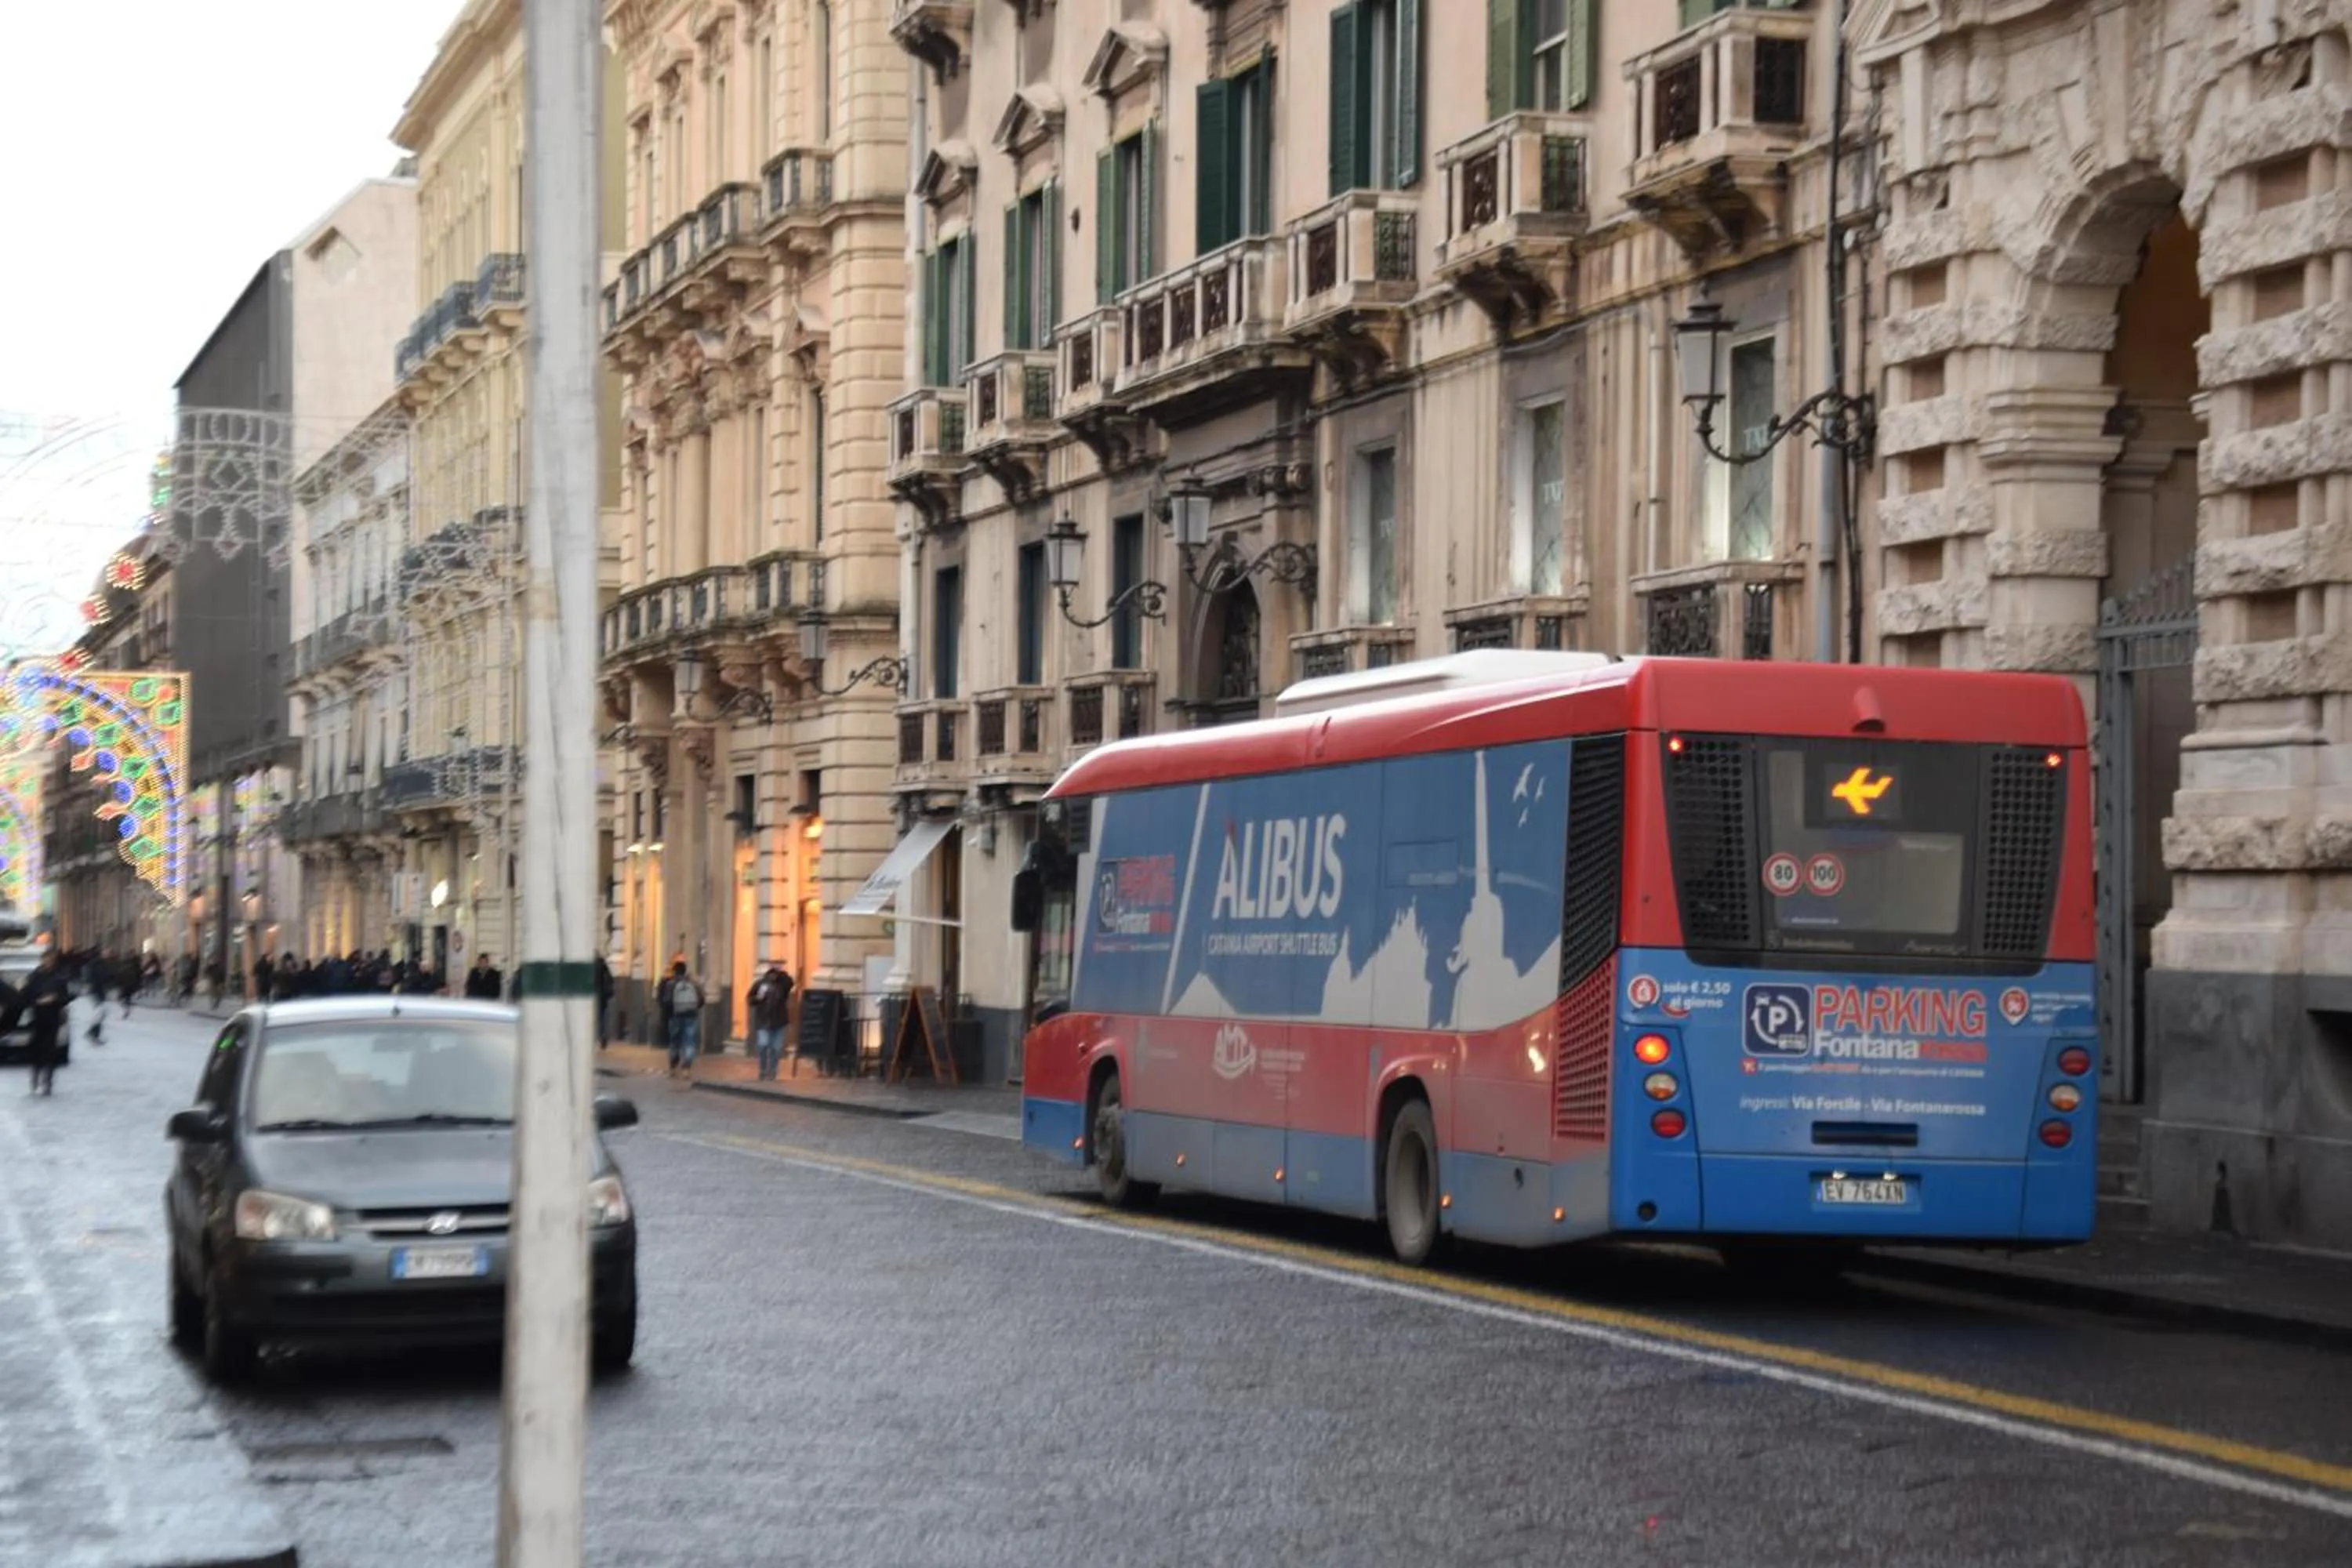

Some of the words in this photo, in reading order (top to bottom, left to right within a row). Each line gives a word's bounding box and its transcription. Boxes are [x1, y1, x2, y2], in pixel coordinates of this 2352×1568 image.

[1212, 813, 1347, 920] ALIBUS
[1774, 864, 1794, 881] 80
[1813, 865, 1836, 882] 100
[1318, 932, 1338, 956] BUS
[1768, 1005, 1788, 1033] P
[1813, 985, 1987, 1037] PARKING
[1813, 1030, 1919, 1059] Fontana
[1792, 1094, 1814, 1110] Via
[1871, 1097, 1892, 1112] Via
